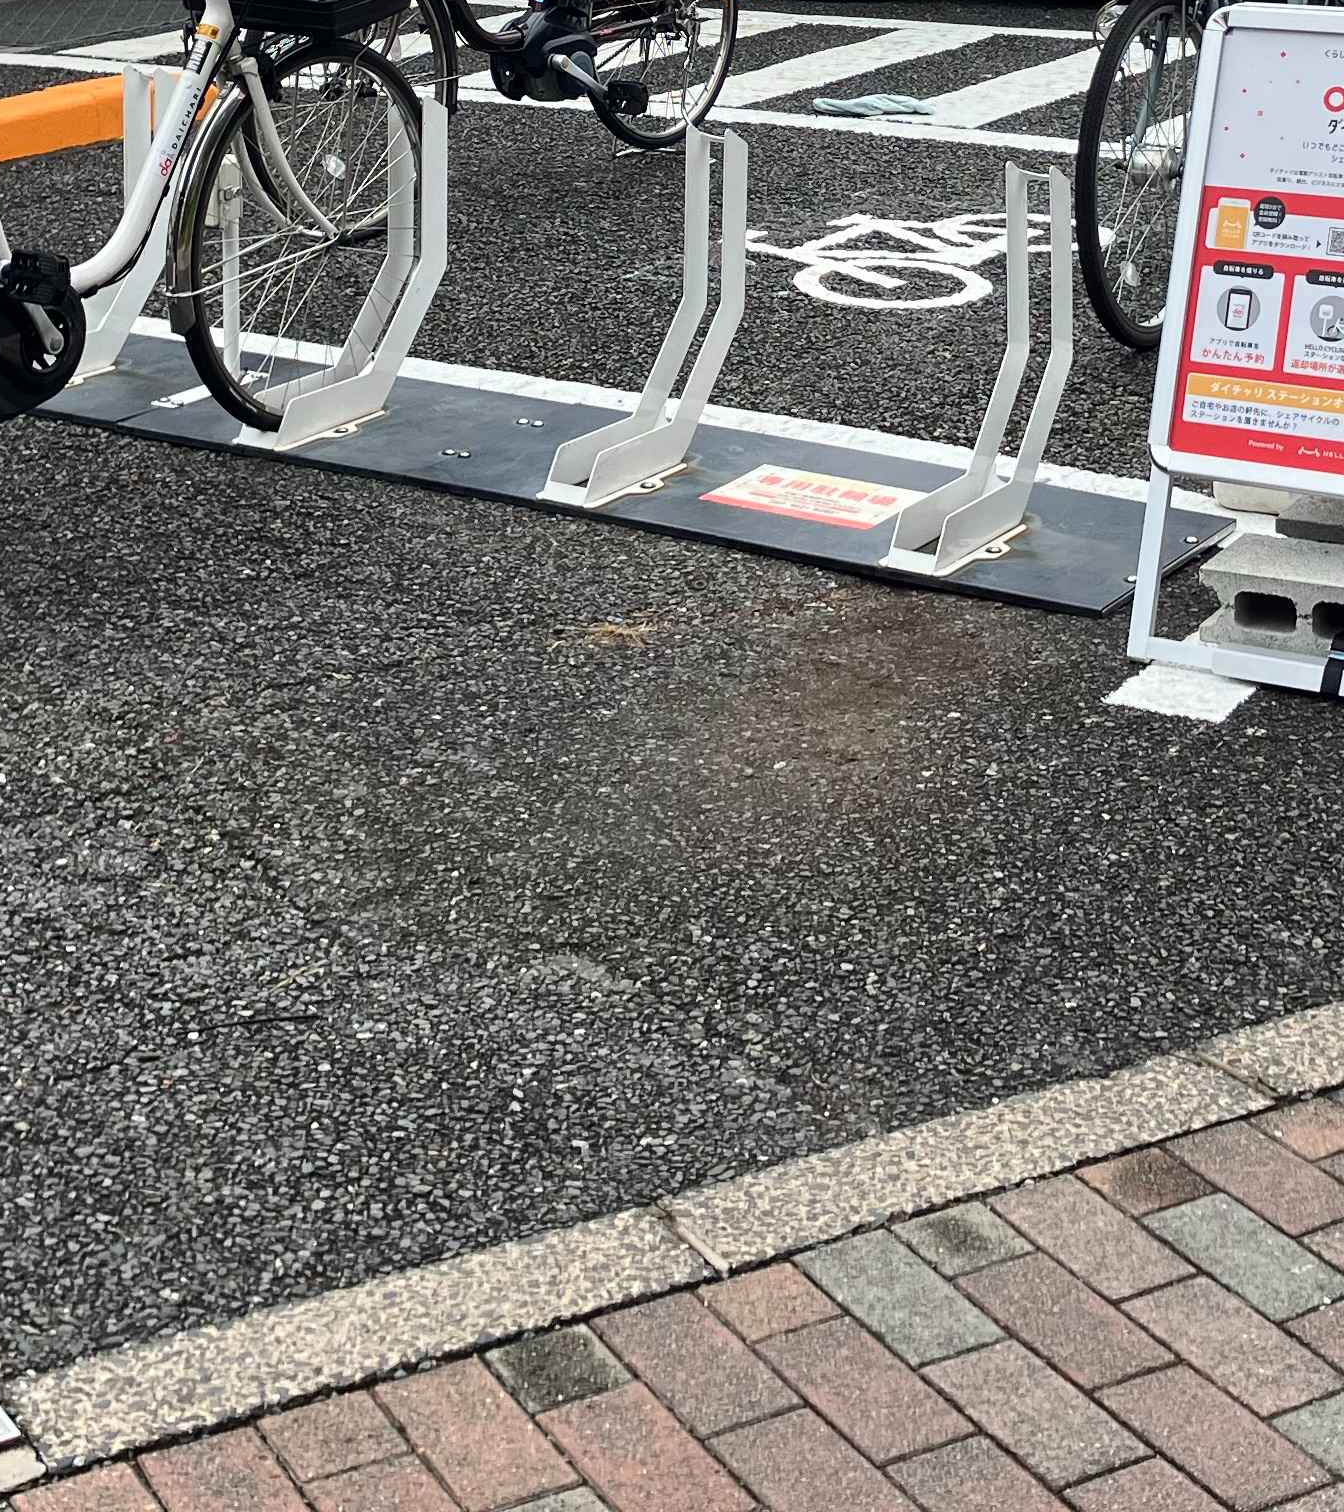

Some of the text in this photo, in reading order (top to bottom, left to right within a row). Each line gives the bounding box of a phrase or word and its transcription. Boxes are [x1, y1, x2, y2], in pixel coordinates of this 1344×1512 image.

[171, 87, 202, 150] DAICHARI
[1200, 349, 1266, 365] かんたん予約
[1208, 381, 1264, 399] ダイチャリ
